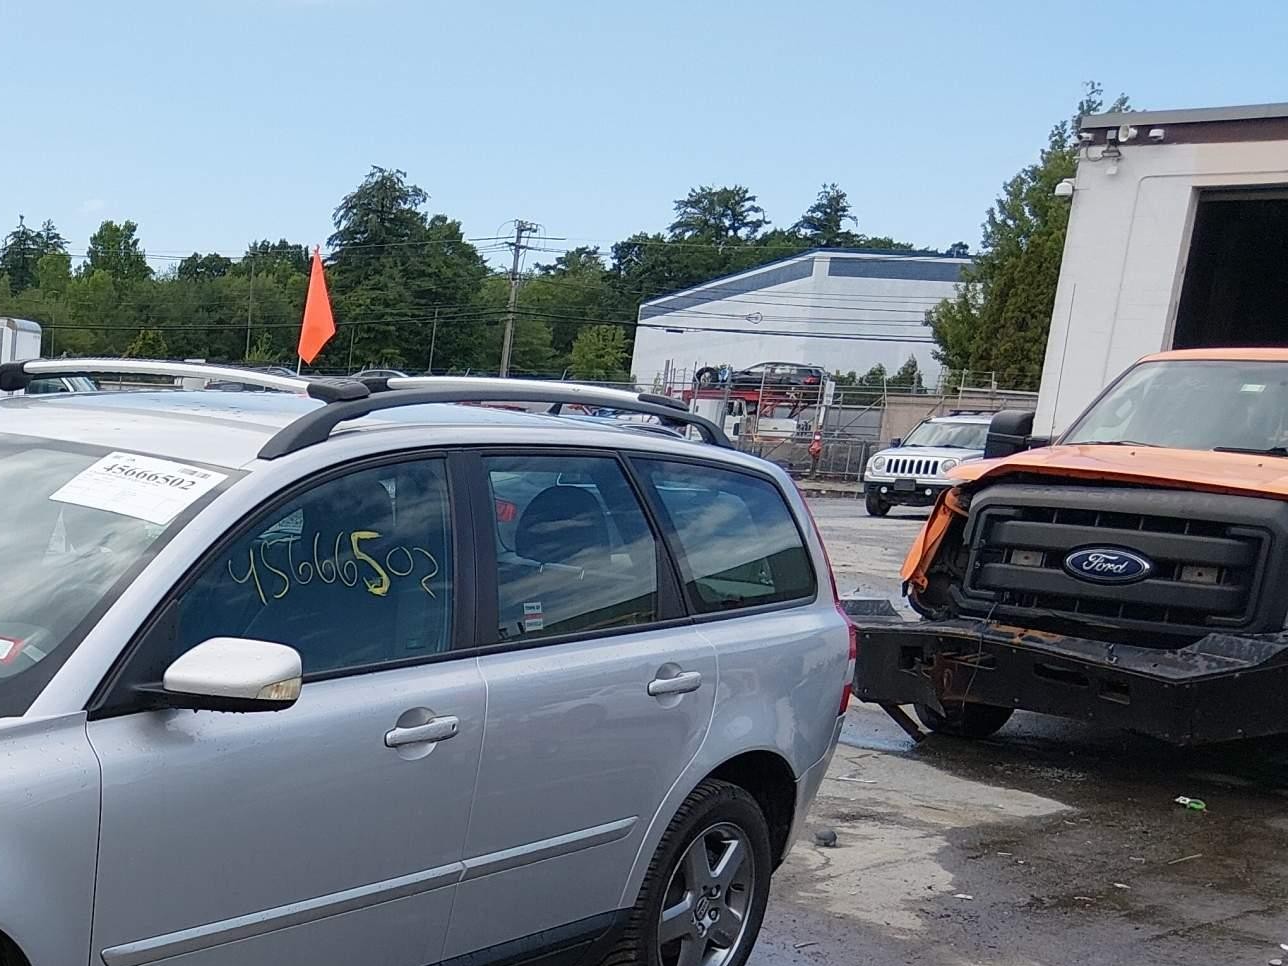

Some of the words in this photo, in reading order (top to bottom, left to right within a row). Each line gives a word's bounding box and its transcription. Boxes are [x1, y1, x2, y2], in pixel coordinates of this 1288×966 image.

[103, 463, 196, 491] 45666502
[228, 530, 439, 606] 45666502
[1082, 553, 1129, 574] Ford
